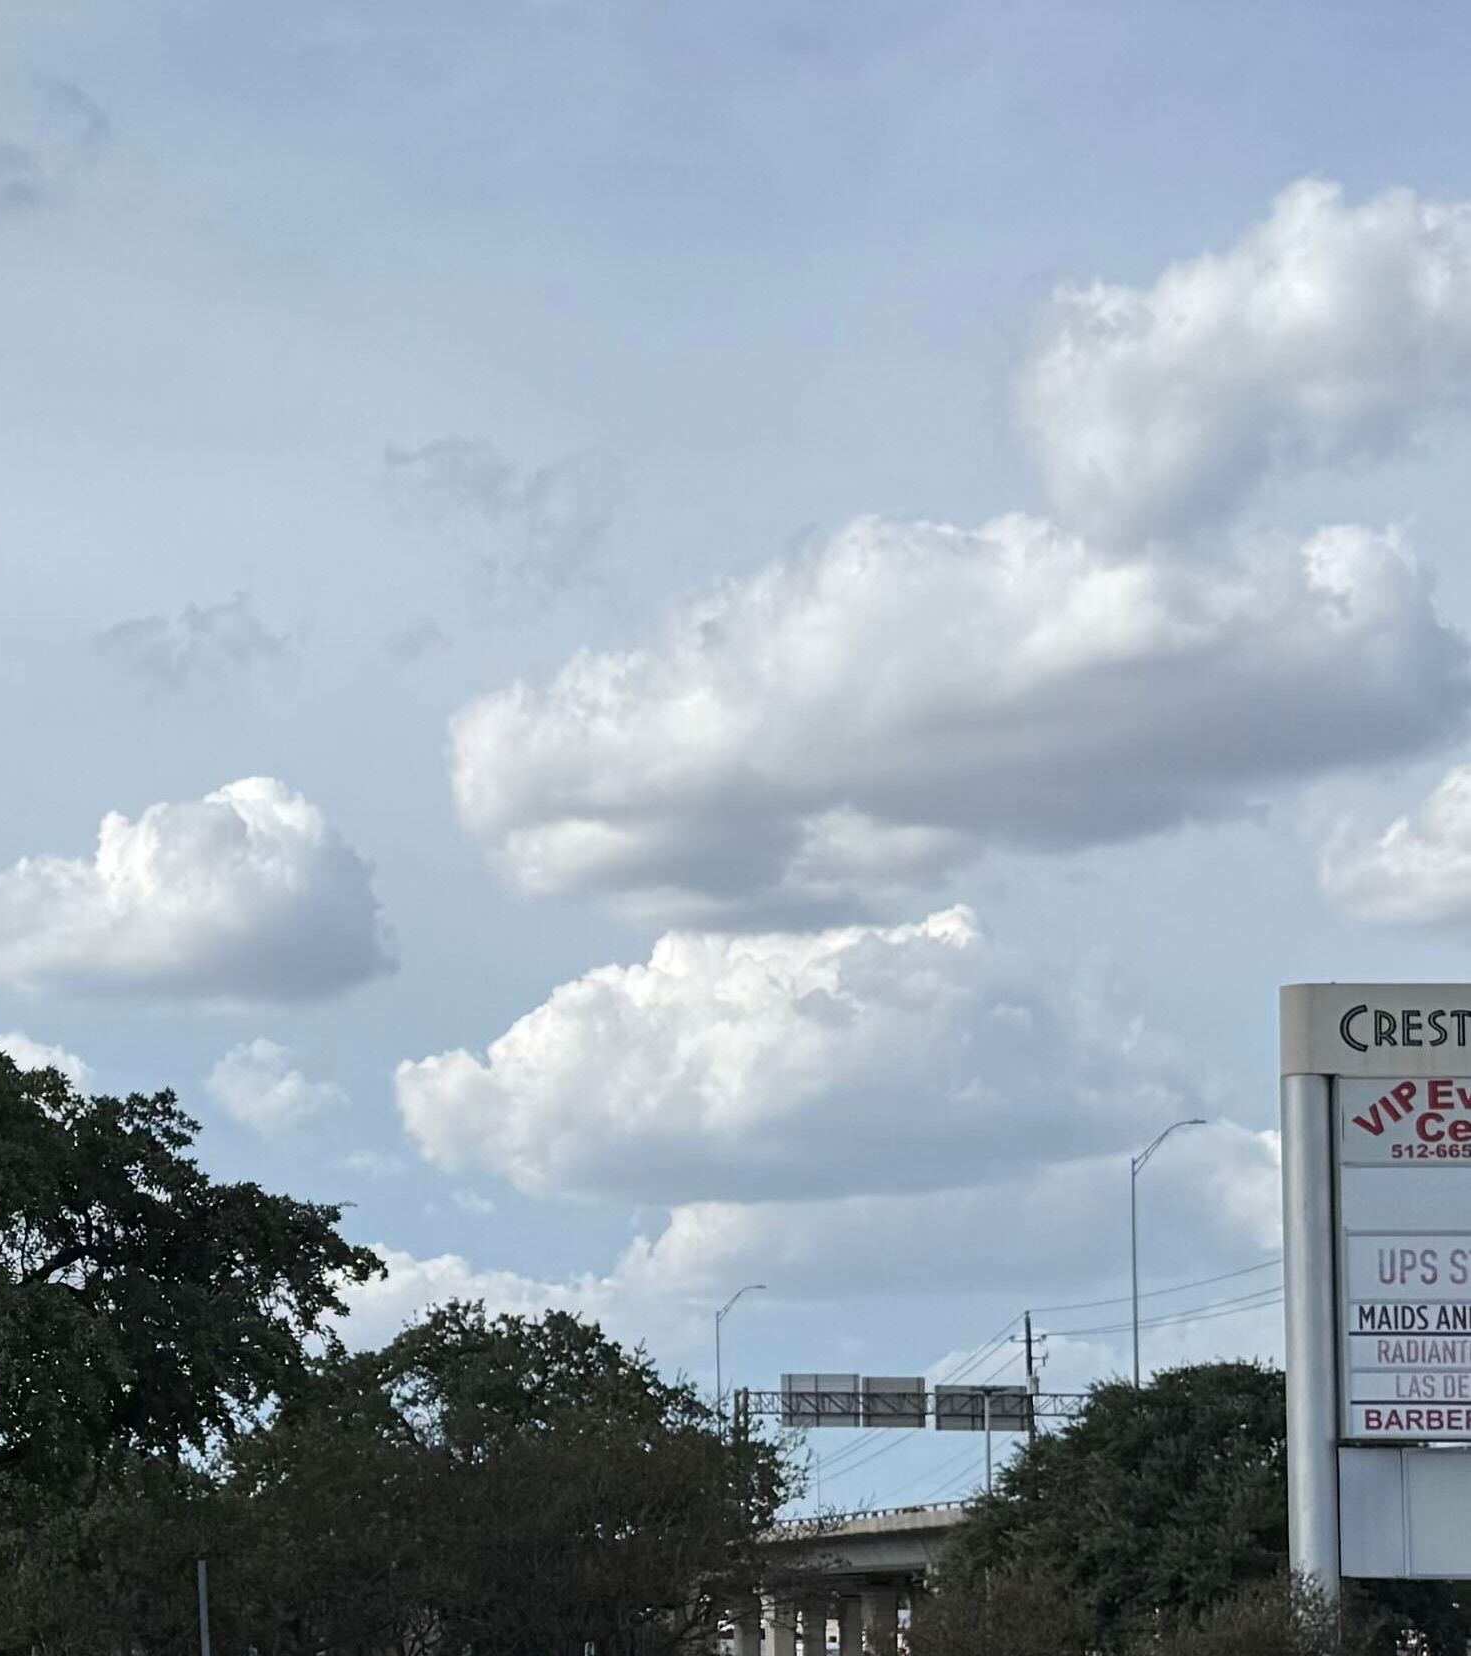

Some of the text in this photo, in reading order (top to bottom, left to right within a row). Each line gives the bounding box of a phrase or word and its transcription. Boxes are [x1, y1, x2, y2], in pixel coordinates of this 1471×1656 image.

[1339, 1003, 1471, 1053] CREST
[1351, 1080, 1417, 1137] VIP
[1415, 1111, 1471, 1143] Ce
[1390, 1144, 1471, 1159] 512-665
[1376, 1248, 1471, 1285] UPS S
[1358, 1304, 1471, 1331] MAIDS AN
[1377, 1339, 1471, 1365] RADIANT
[1395, 1374, 1436, 1399] LAS
[1364, 1409, 1471, 1431] BARBE
